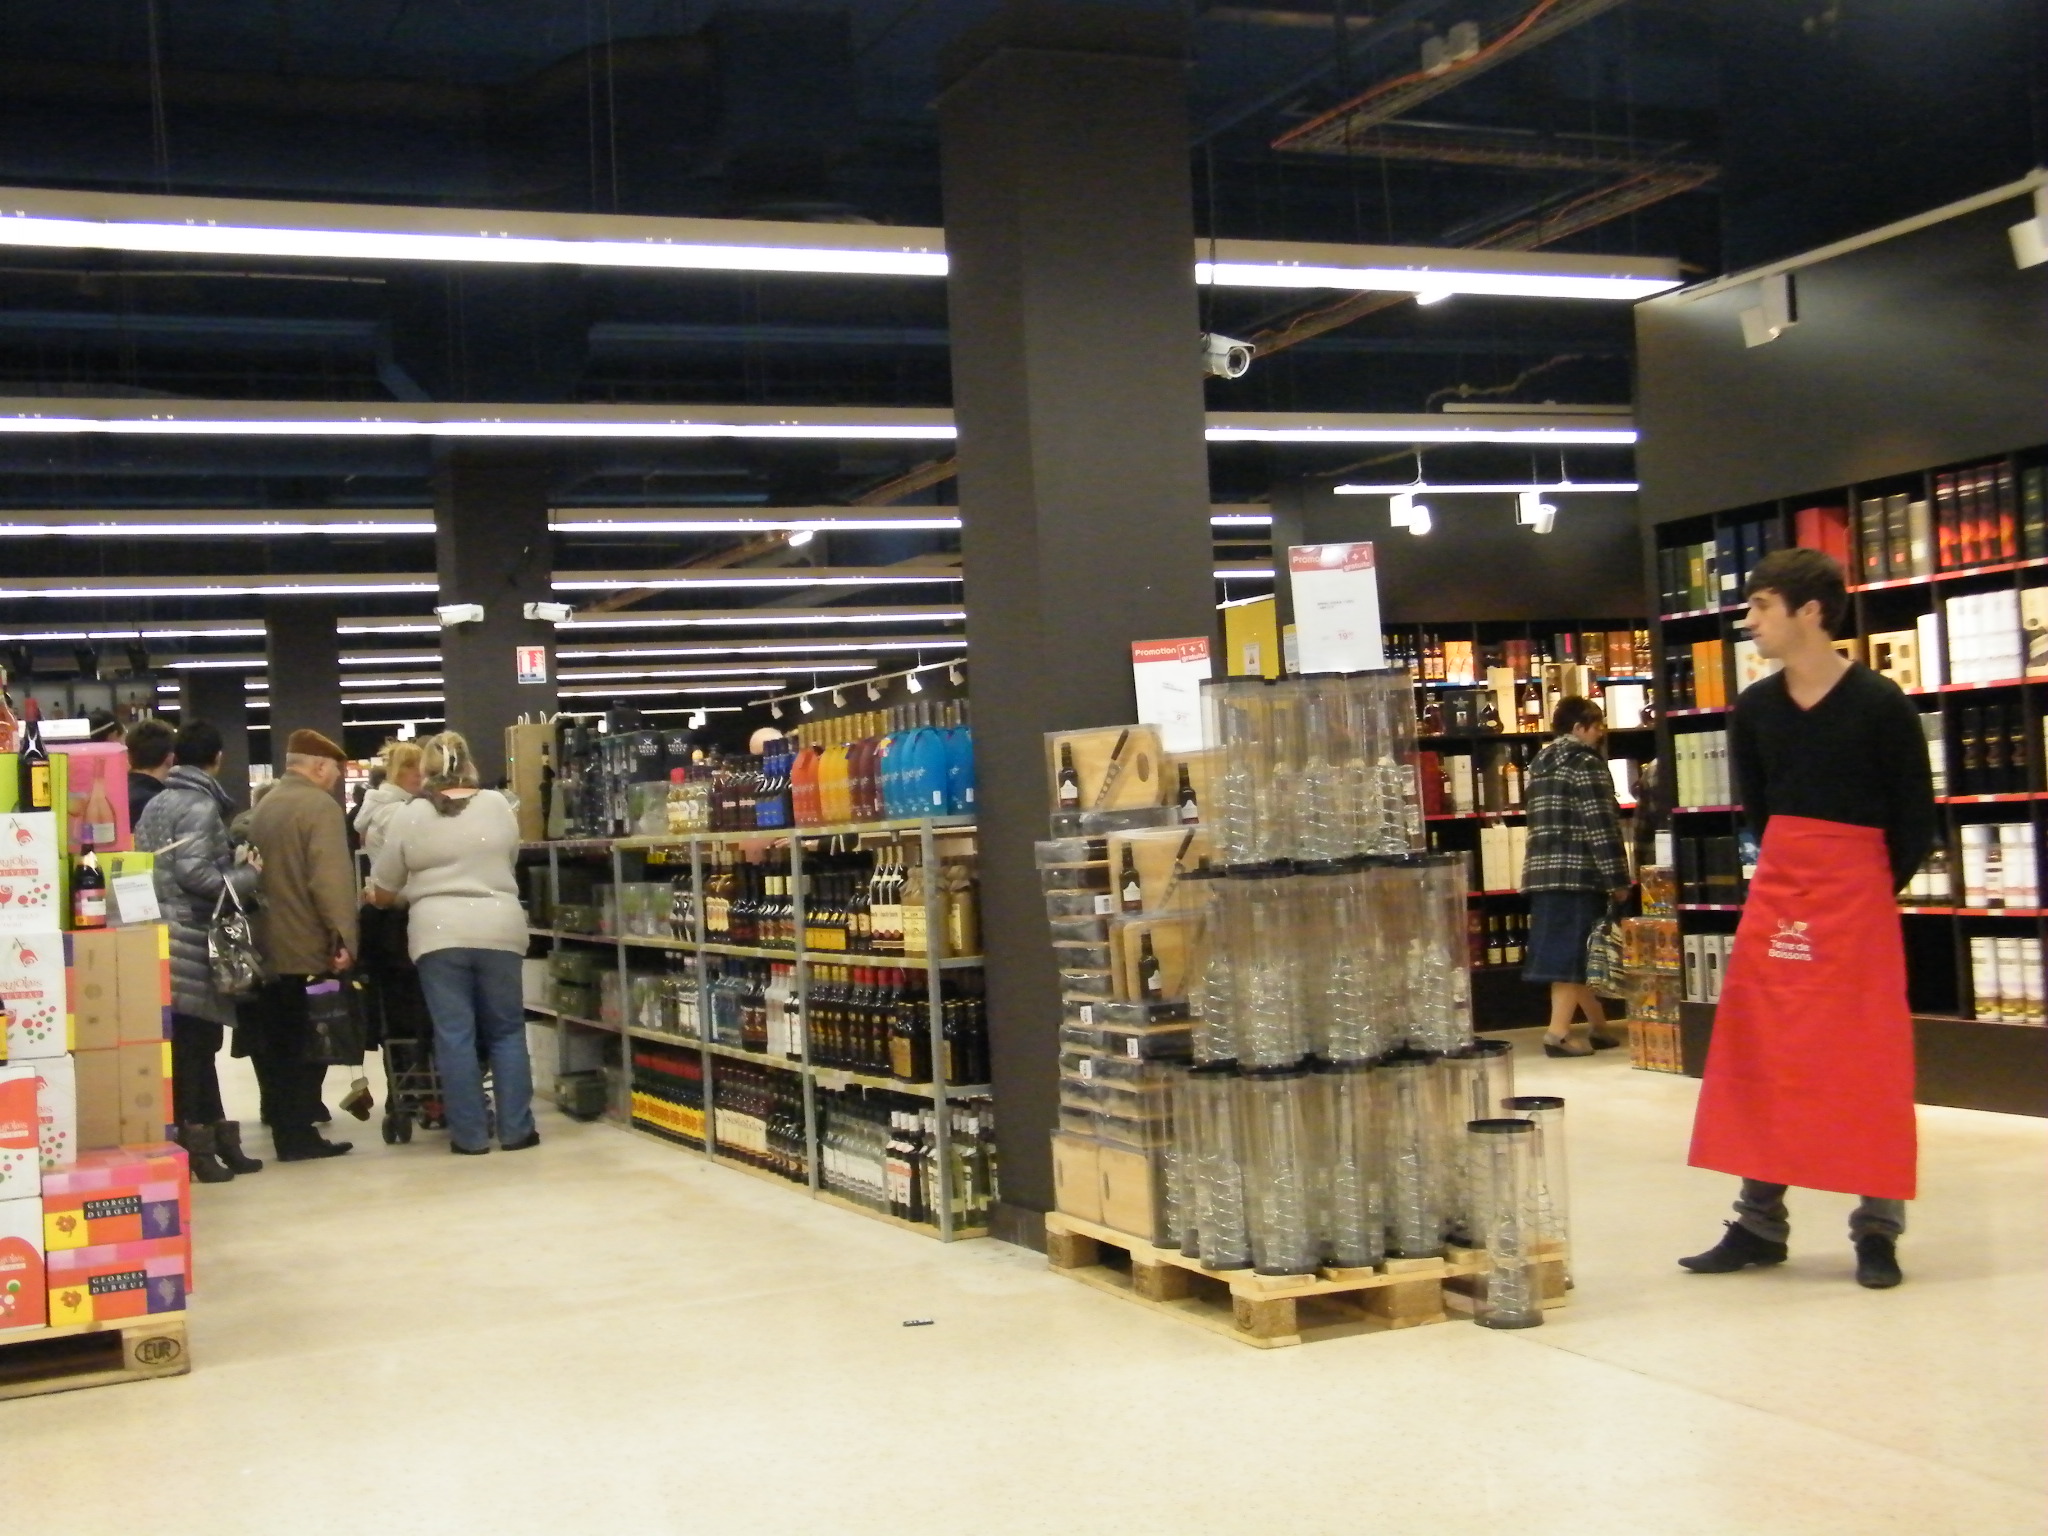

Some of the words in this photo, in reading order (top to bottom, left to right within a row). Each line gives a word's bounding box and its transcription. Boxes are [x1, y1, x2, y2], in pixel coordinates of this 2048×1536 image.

[1135, 647, 1176, 656] Promotion
[1769, 949, 1811, 960] Boissons
[87, 1197, 139, 1210] GEORGES
[92, 1271, 144, 1284] GEORGES
[143, 1341, 171, 1361] EUR
